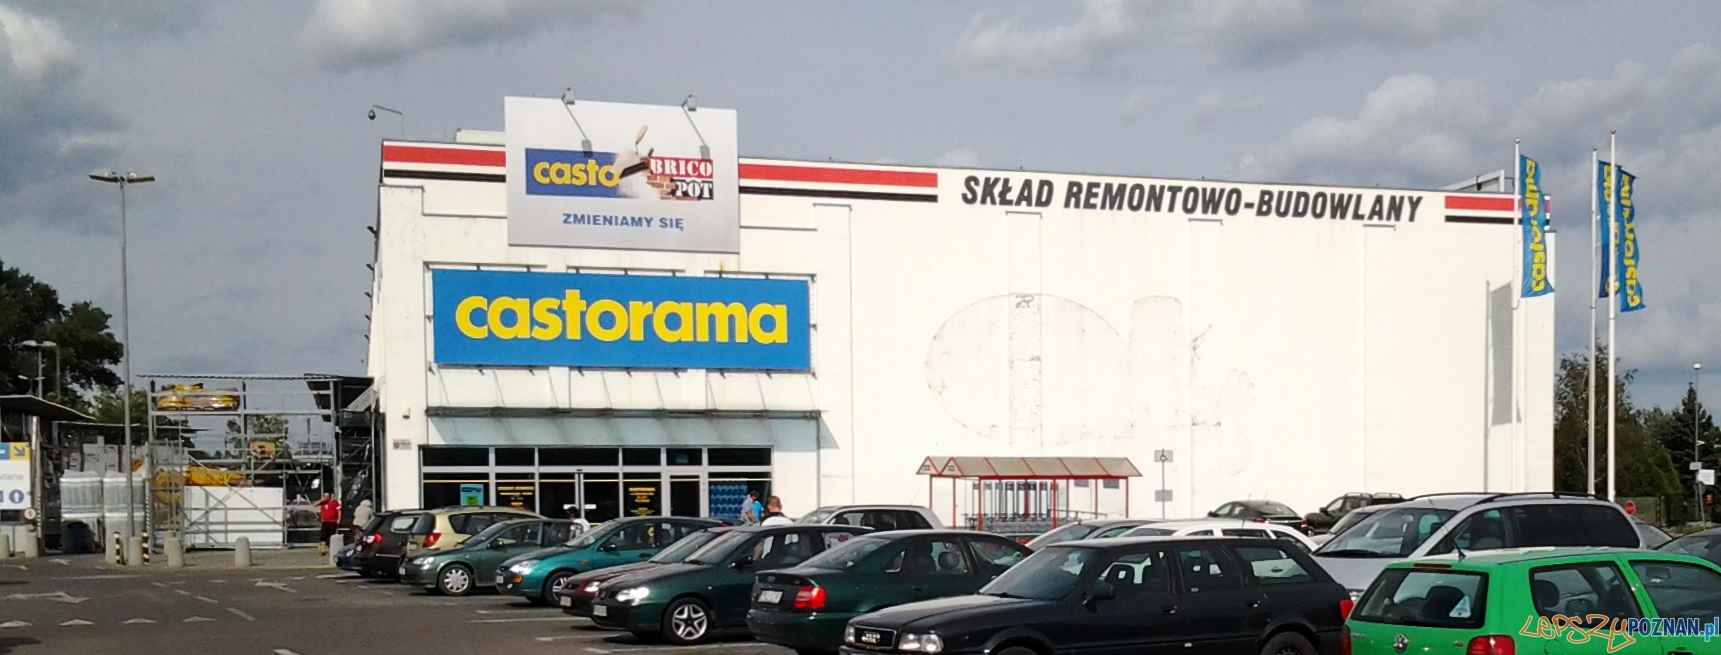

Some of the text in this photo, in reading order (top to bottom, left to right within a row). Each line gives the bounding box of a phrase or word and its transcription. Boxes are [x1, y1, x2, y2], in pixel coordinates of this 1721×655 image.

[532, 159, 621, 188] casto
[650, 158, 713, 177] BRICO
[674, 180, 713, 199] POT
[961, 175, 1423, 222] SKŁAD REMONTOWO-BUDOWLANY
[562, 212, 684, 232] ZMIENIAMY SIĘ
[455, 289, 788, 345] castorama
